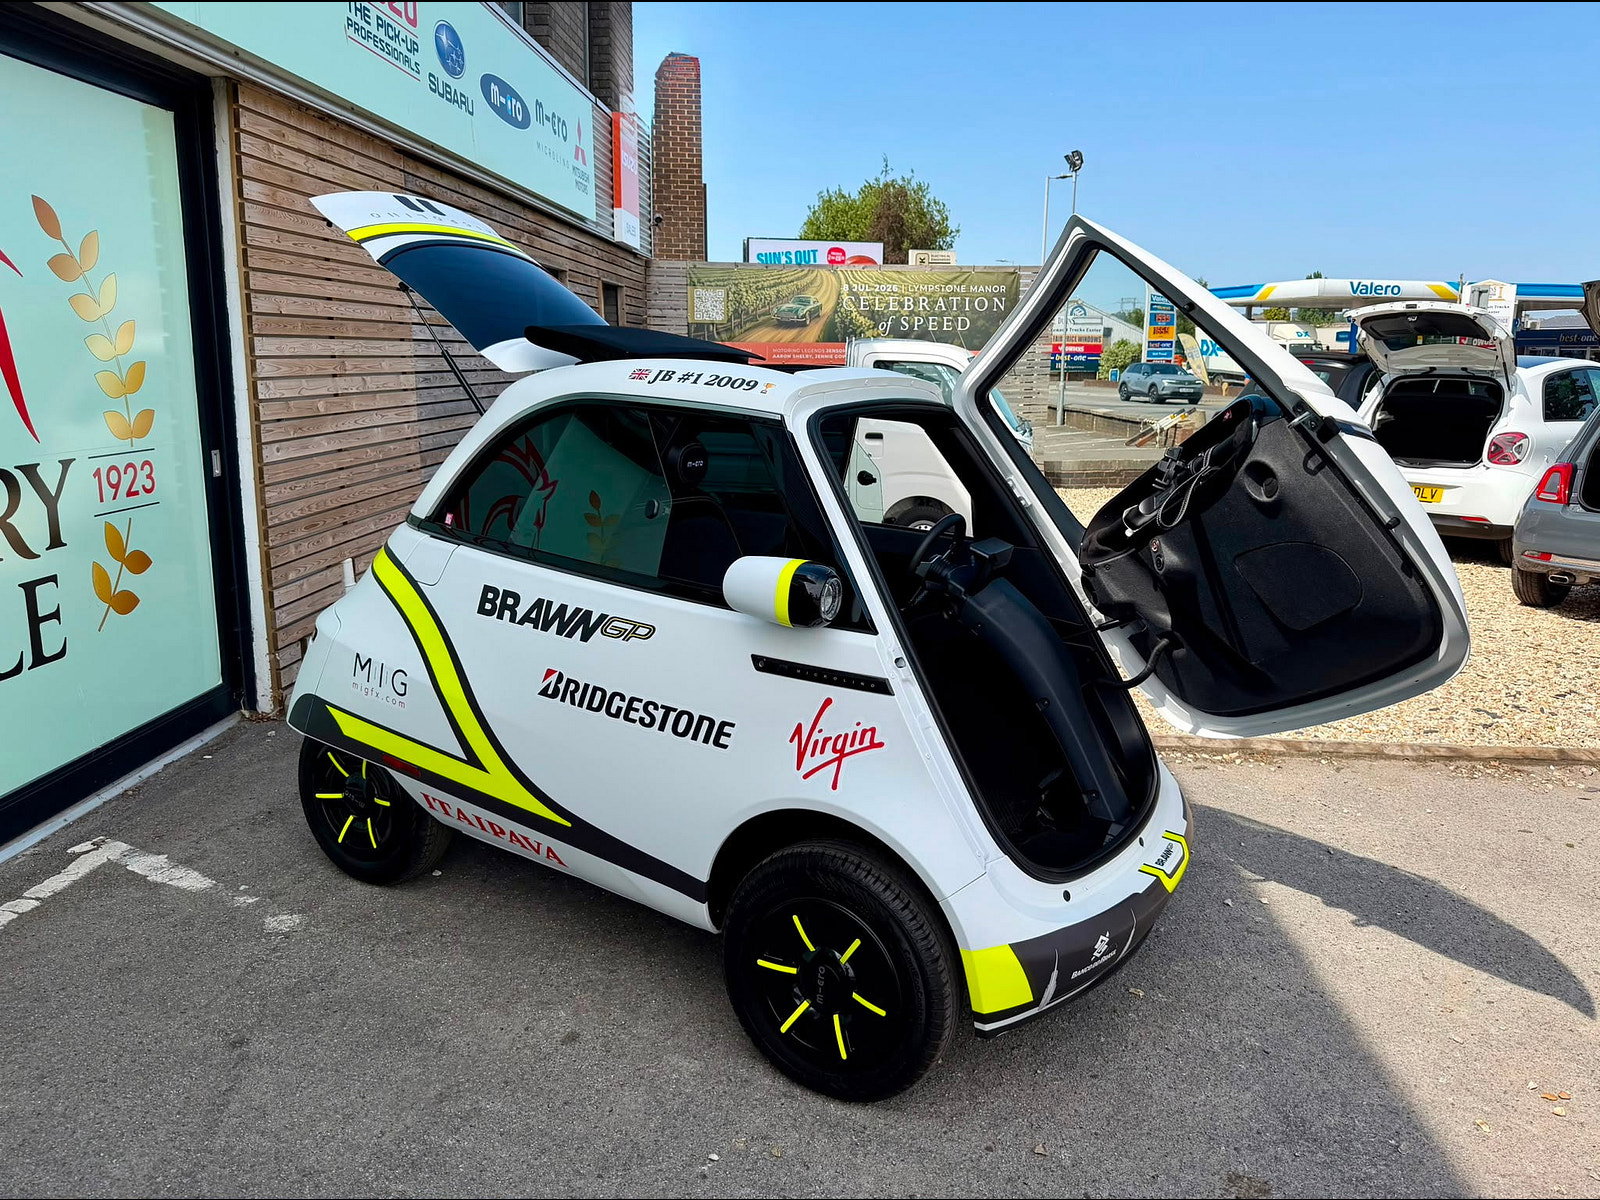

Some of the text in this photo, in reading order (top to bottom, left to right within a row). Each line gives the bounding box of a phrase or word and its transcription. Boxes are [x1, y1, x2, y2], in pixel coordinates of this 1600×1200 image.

[348, 2, 371, 27] THE
[376, 14, 419, 56] PICK-UP
[346, 16, 420, 75] PROFESSIONALS
[428, 71, 474, 117] SUBARU
[756, 250, 792, 265] SUN'S
[794, 249, 818, 265] OUT
[852, 284, 871, 292] JUL
[875, 285, 898, 293] 2026
[908, 285, 966, 293] LYMPSTONE
[969, 285, 1006, 293] MANOR
[1349, 281, 1401, 296] Valero
[843, 296, 1006, 312] CELEBRATION
[878, 315, 971, 337] of SPEED
[1201, 339, 1219, 356] DX
[647, 369, 759, 391] JB #1 2009
[92, 459, 156, 503] 1923
[1414, 487, 1438, 500] DLV
[796, 669, 875, 688] MICROLINO
[352, 682, 407, 709] migfx.com
[537, 668, 736, 750] BRIDGESTONE
[788, 697, 885, 791] Virgin
[420, 791, 569, 869] ITAIPAVA
